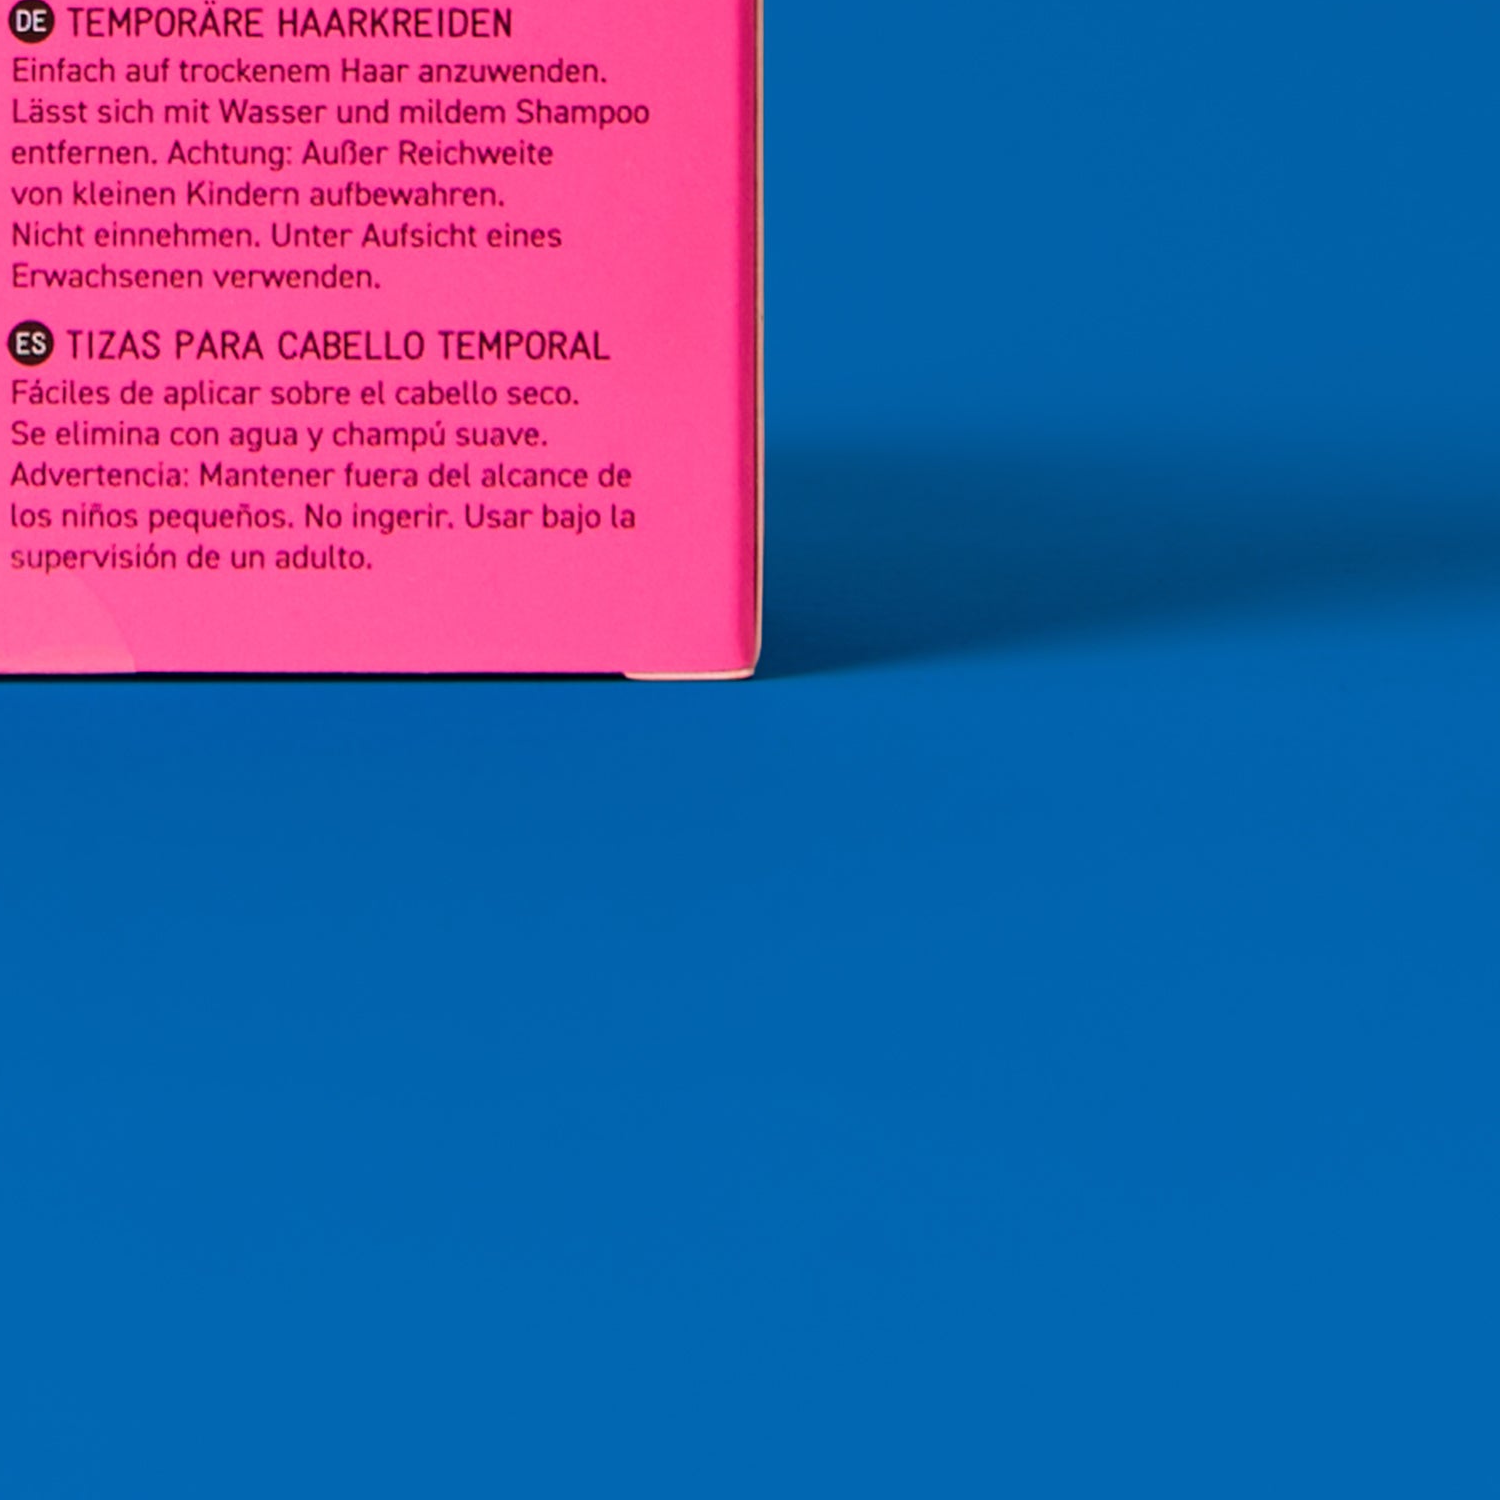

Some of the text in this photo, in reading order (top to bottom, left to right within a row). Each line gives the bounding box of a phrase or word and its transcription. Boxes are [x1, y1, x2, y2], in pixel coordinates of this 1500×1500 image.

[14, 0, 512, 39] DE TEMPORÄRE HAARKREIDEN
[12, 56, 607, 84] Einfach auf trockenem Haar anzuwenden.
[12, 98, 650, 130] Lässt sich mit Wasser und mildem Shampoo
[11, 139, 554, 172] entfernen. Achtung: Außer Reichweite
[11, 180, 504, 207] von kleinen Kindern aufbewahren.
[12, 221, 563, 249] Nicht einnehmen. Unter Aufsicht eines
[12, 262, 381, 290] Erwachsenen verwenden.
[14, 328, 611, 361] ES TIZAS PARA CABELLO TEMPORAL
[11, 379, 579, 412] Fáciles de aplicar sobre el cabello seco.
[10, 502, 636, 535] los niños pequeños. No ingerir. Usar bajo la
[10, 542, 372, 574] supervisión de un adulto.
